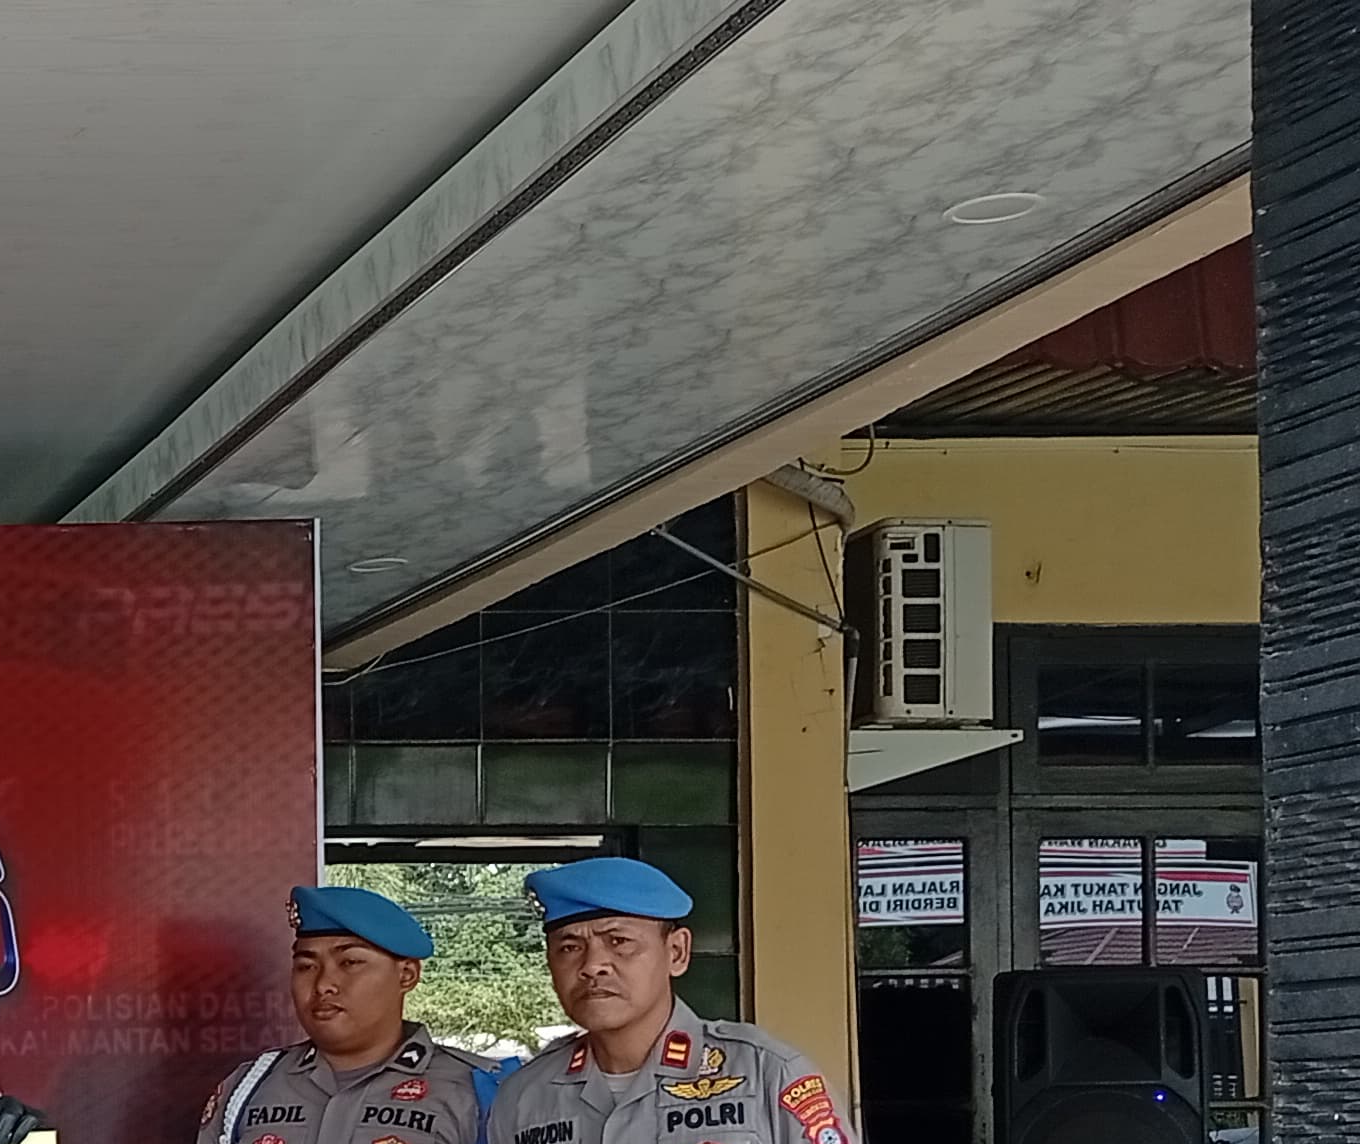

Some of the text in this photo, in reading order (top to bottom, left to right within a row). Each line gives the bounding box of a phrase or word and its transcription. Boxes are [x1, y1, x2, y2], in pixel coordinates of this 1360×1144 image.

[199, 1024, 292, 1053] SELAT
[246, 1105, 306, 1127] FADIL
[361, 1106, 439, 1133] POLRI
[667, 1101, 745, 1133] POLRI
